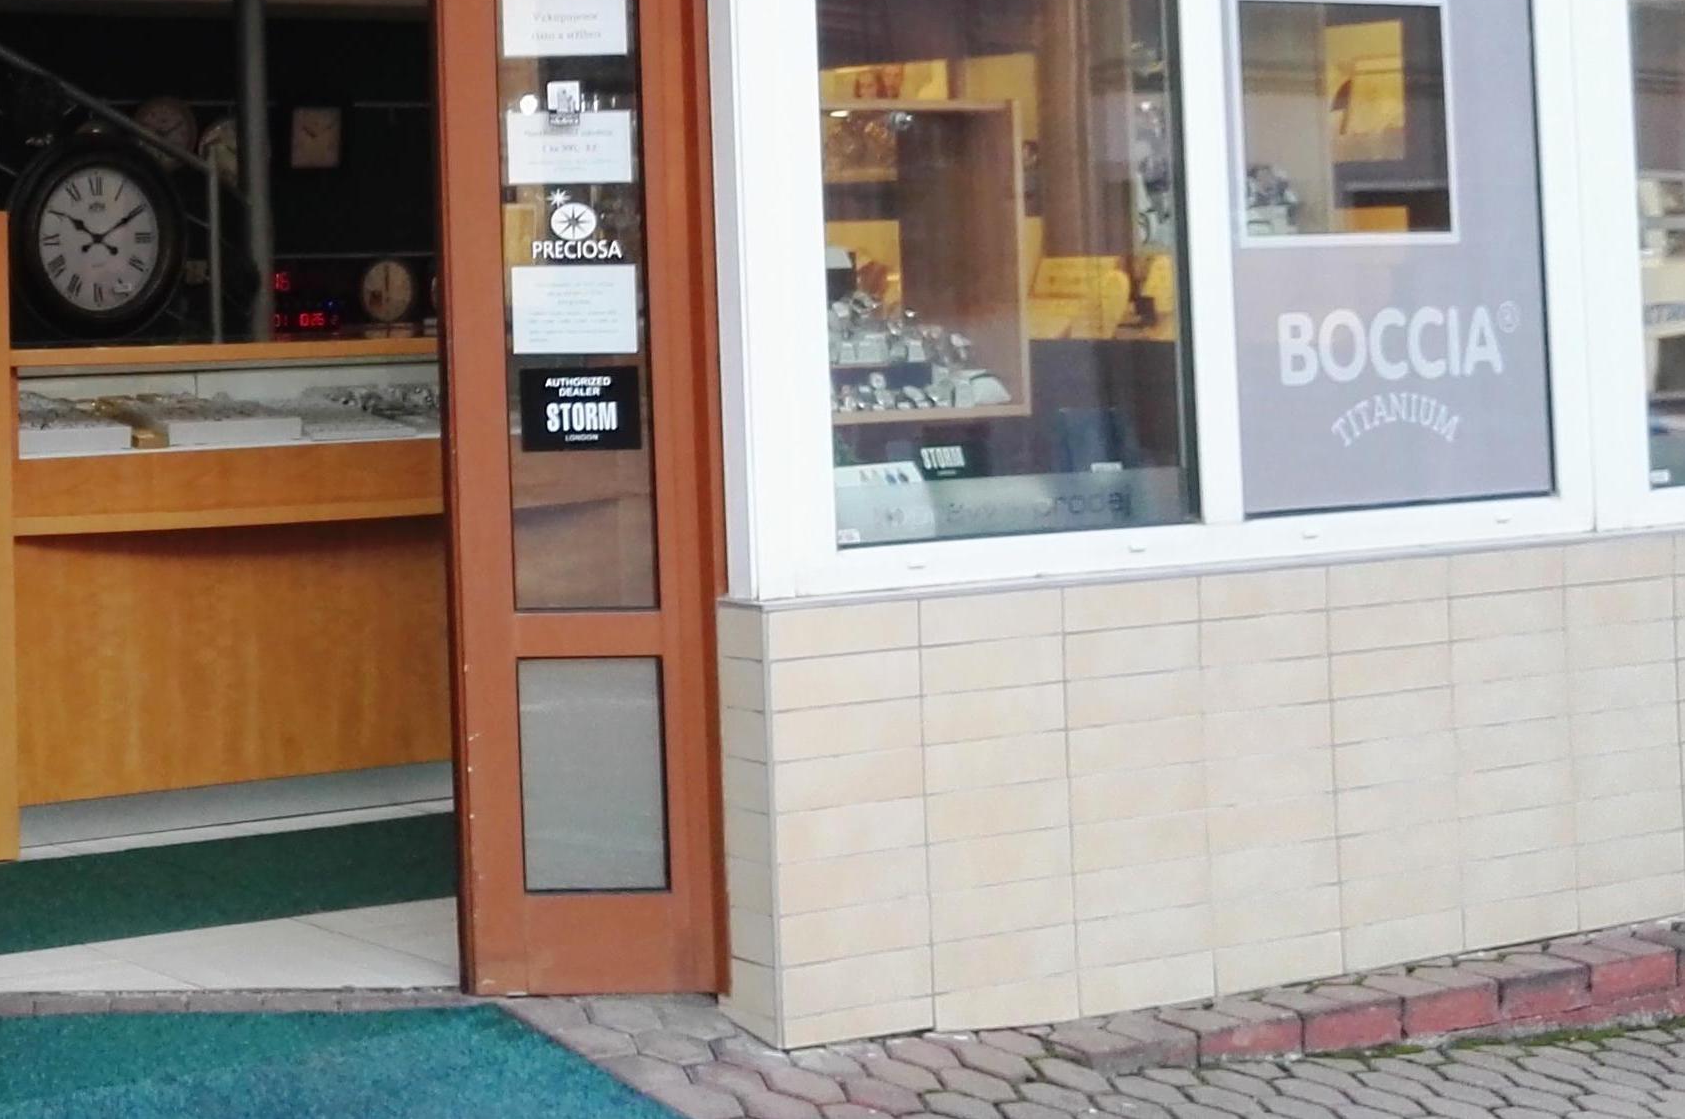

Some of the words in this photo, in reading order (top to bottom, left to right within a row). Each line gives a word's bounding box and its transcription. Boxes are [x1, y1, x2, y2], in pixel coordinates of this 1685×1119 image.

[531, 239, 623, 260] PRECIOSA
[1277, 305, 1504, 386] BOCCIA
[545, 376, 611, 388] AUTHORIZED
[559, 387, 601, 397] DEALER
[546, 401, 619, 432] STORM
[1331, 392, 1460, 448] TITANIUM
